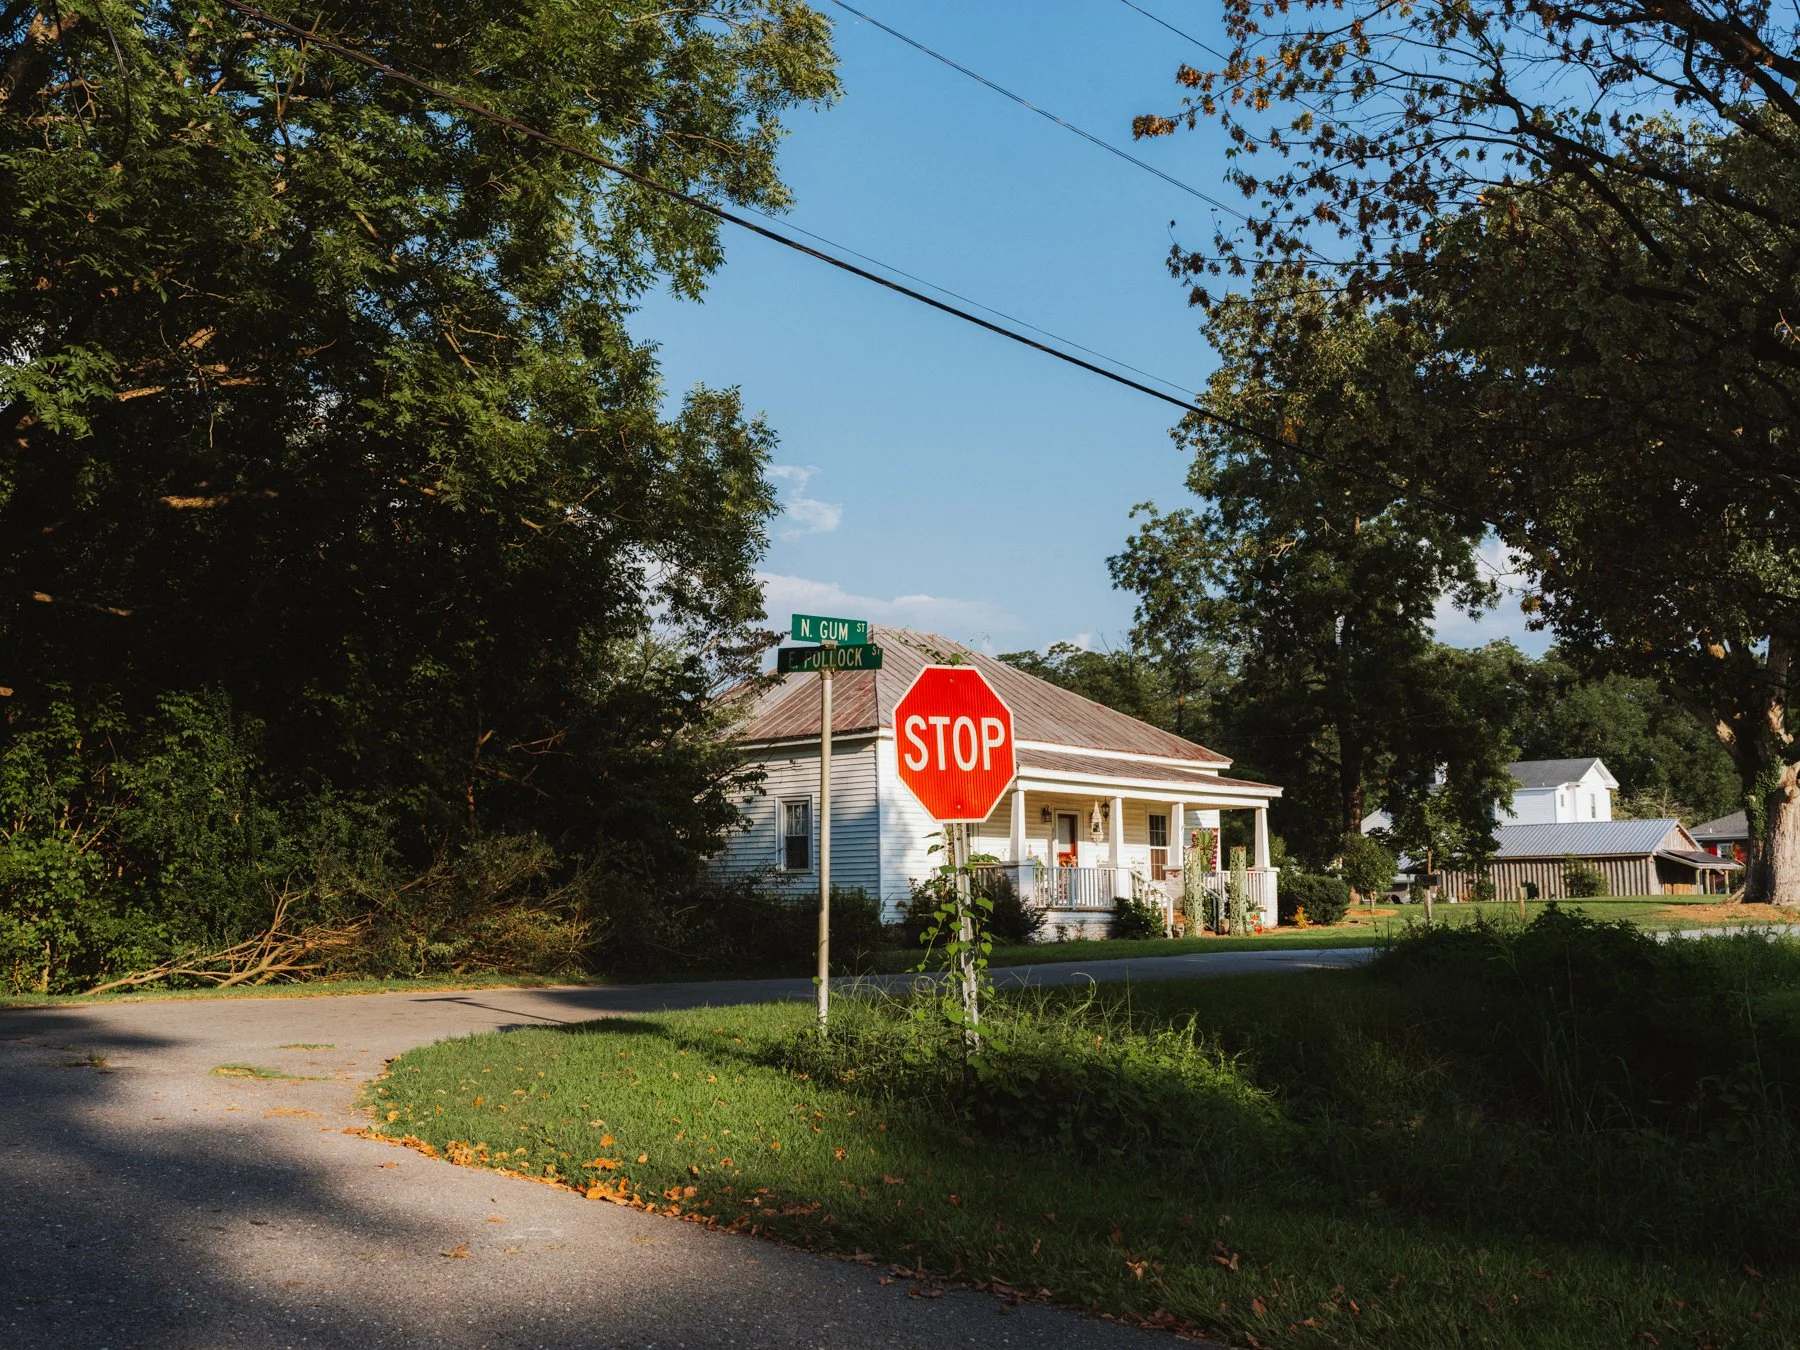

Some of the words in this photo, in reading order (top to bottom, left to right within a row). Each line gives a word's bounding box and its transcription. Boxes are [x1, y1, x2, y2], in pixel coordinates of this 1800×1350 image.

[801, 618, 812, 638] N.
[820, 620, 849, 641] GUM
[856, 622, 866, 633] ST
[788, 651, 798, 669] E.
[804, 647, 863, 669] POLLOCK
[904, 714, 1006, 772] STOP
